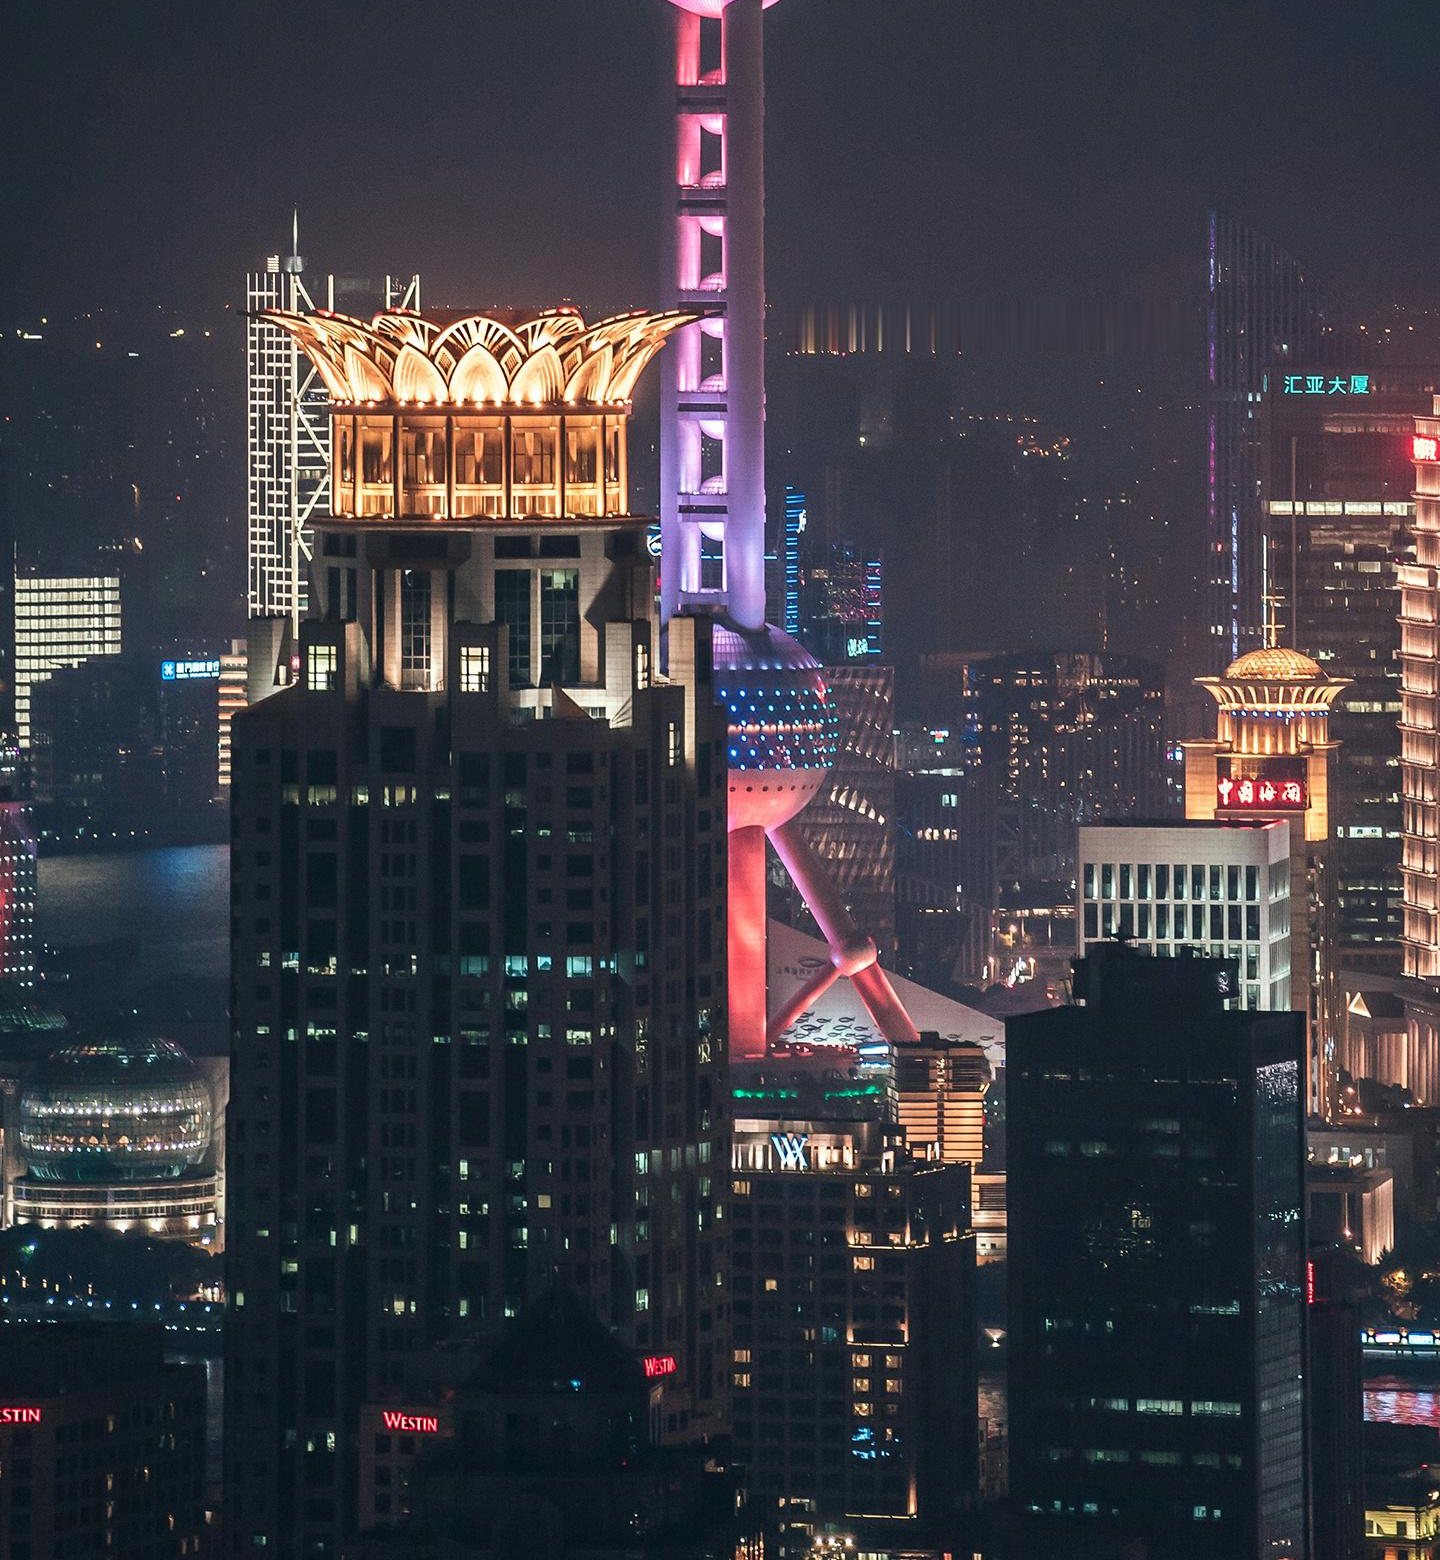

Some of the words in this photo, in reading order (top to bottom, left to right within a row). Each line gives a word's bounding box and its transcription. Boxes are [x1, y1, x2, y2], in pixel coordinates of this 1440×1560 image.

[1284, 375, 1369, 395] 汇亚大厦
[0, 1407, 41, 1423] STIN
[383, 1411, 438, 1433] WESTIN
